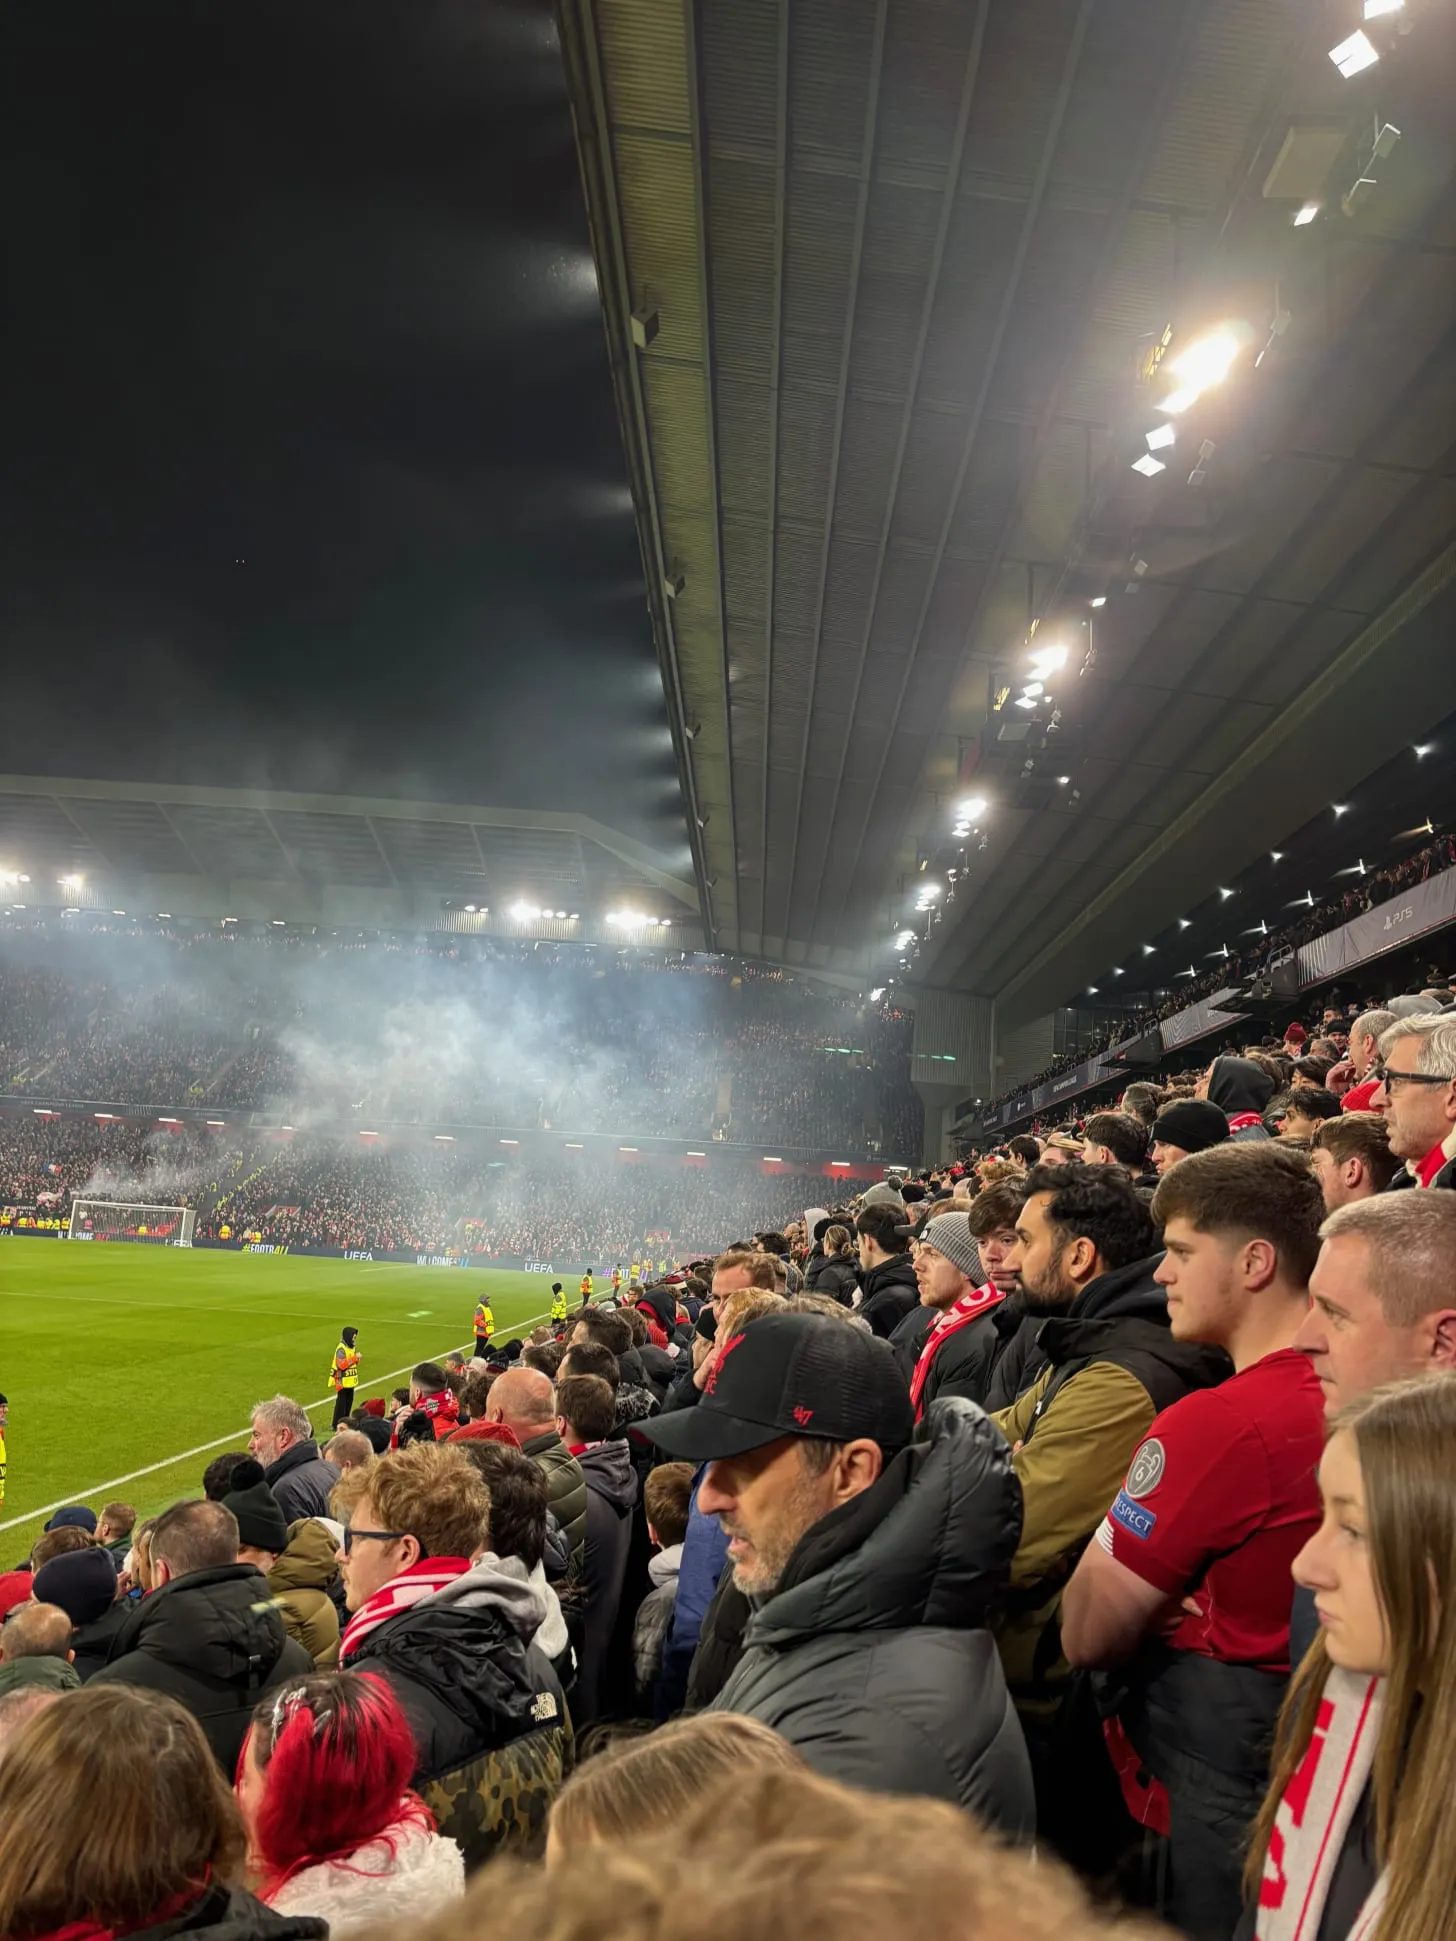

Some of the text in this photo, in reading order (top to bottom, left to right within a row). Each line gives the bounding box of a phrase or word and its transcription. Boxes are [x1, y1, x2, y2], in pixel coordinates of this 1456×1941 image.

[1393, 906, 1413, 925] PS5
[344, 1250, 373, 1261] UEFA
[524, 1262, 554, 1274] UEFA
[1135, 1466, 1145, 1481] 6
